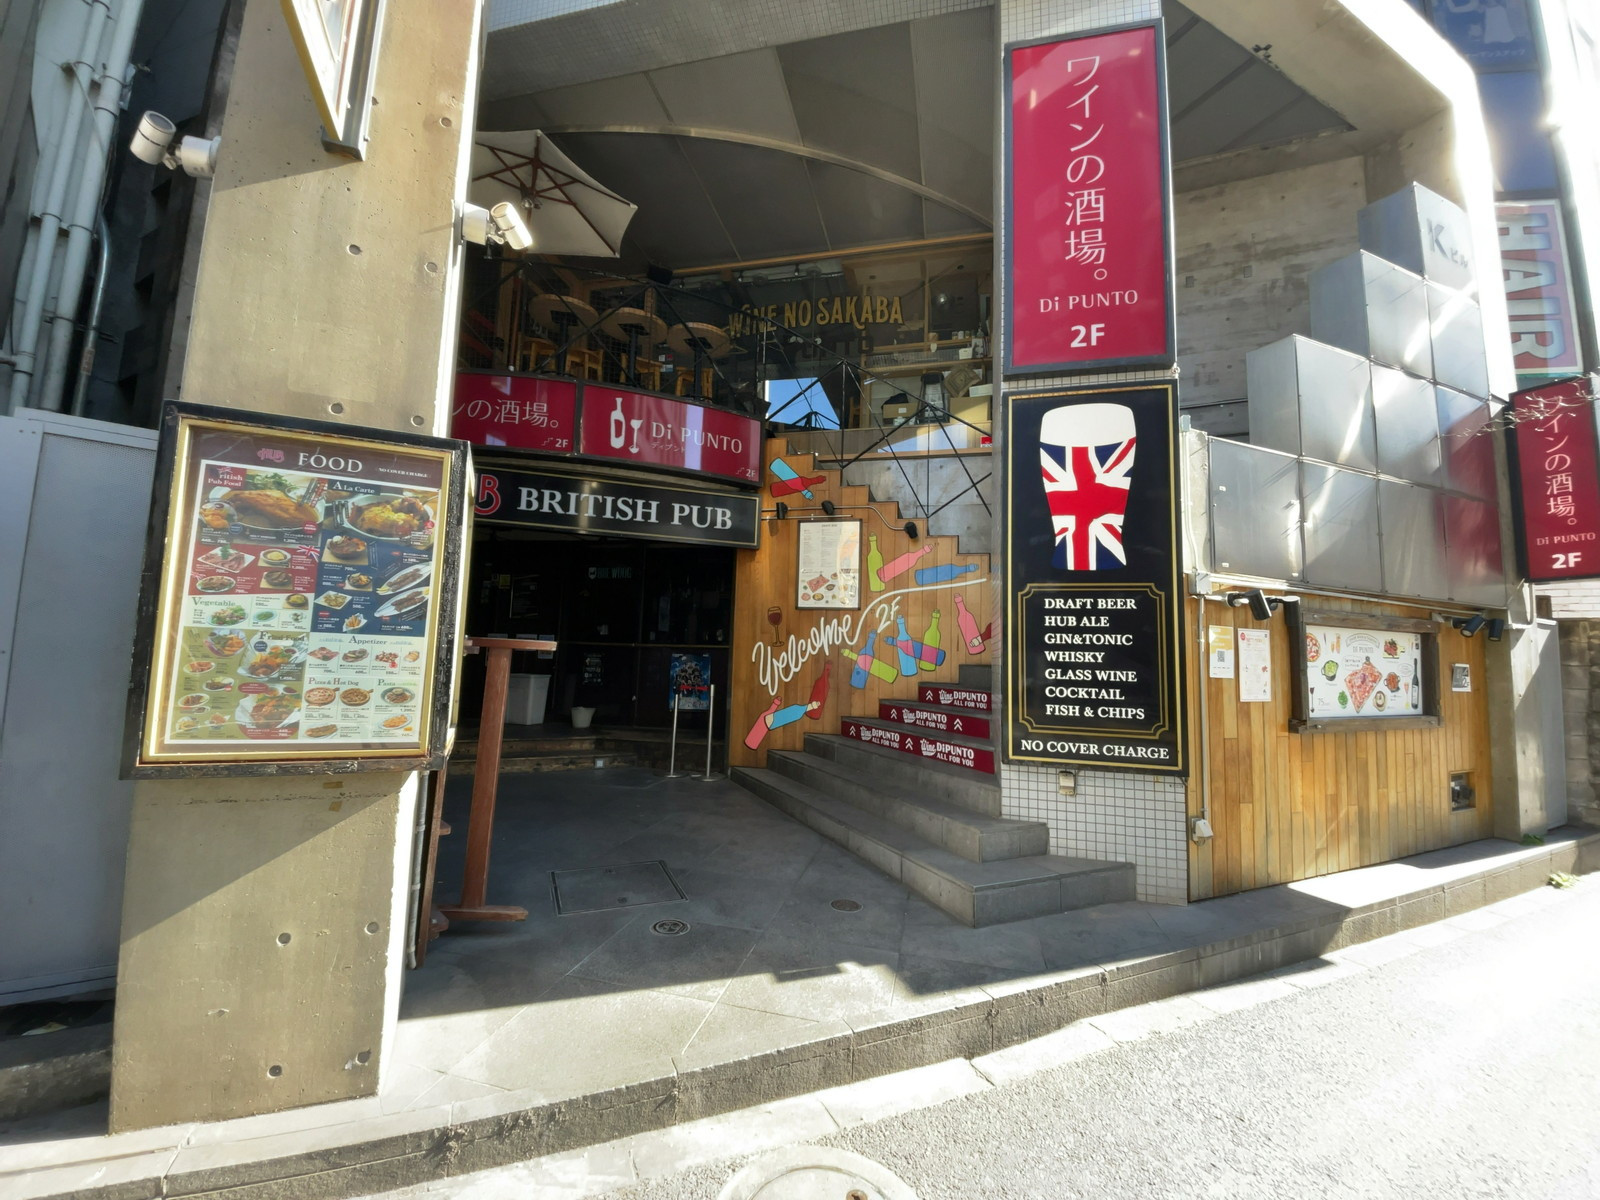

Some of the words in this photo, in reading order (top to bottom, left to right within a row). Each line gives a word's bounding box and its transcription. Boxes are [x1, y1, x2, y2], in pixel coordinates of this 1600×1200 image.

[1064, 55, 1108, 281] ワインの酒場。
[1496, 213, 1566, 360] HAIR
[1039, 296, 1059, 313] Di
[1068, 289, 1139, 310] PUNTO
[783, 299, 812, 329] NO
[816, 295, 904, 330] SAKABA
[1070, 323, 1106, 348] 2F
[554, 438, 569, 448] 2F
[651, 421, 673, 440] Di
[680, 427, 743, 454] PUNTO
[298, 452, 363, 473] FOOD
[745, 468, 757, 478] 2F
[333, 481, 343, 490] A
[355, 486, 375, 494] Carte
[517, 486, 660, 524] BRITISH
[670, 502, 733, 531] PUB
[1536, 536, 1550, 546] Di
[1553, 532, 1596, 544] PUNTO
[1551, 552, 1583, 569] 2F
[192, 596, 236, 607] Vegetable
[1044, 598, 1094, 609] DRAFT
[1097, 598, 1137, 610] BEER
[1044, 615, 1077, 627] HUB
[1080, 616, 1110, 627] ALE
[348, 635, 388, 645] Appetizer
[752, 614, 856, 696] Welcome
[875, 595, 903, 634] 2F
[1044, 633, 1133, 645] GIN&TONIC
[1044, 651, 1105, 663] WHISKY
[308, 677, 326, 685] Pizza
[333, 677, 346, 686] Hot
[377, 678, 396, 686] Pasta
[1045, 668, 1092, 681] GLASS
[1095, 670, 1138, 682] WINE
[1045, 686, 1125, 700] COCKTAIL
[1045, 704, 1081, 717] FISH
[1083, 707, 1095, 717] &
[1097, 706, 1145, 719] CHIPS
[926, 721, 936, 729] FOR
[936, 722, 947, 730] YOU
[890, 740, 900, 749] YOU
[1020, 739, 1044, 752] NO
[1046, 741, 1100, 755] COVER
[1102, 744, 1170, 759] CHARGE
[936, 752, 948, 761] ALL
[949, 754, 961, 764] FOR
[962, 756, 975, 768] YOU
